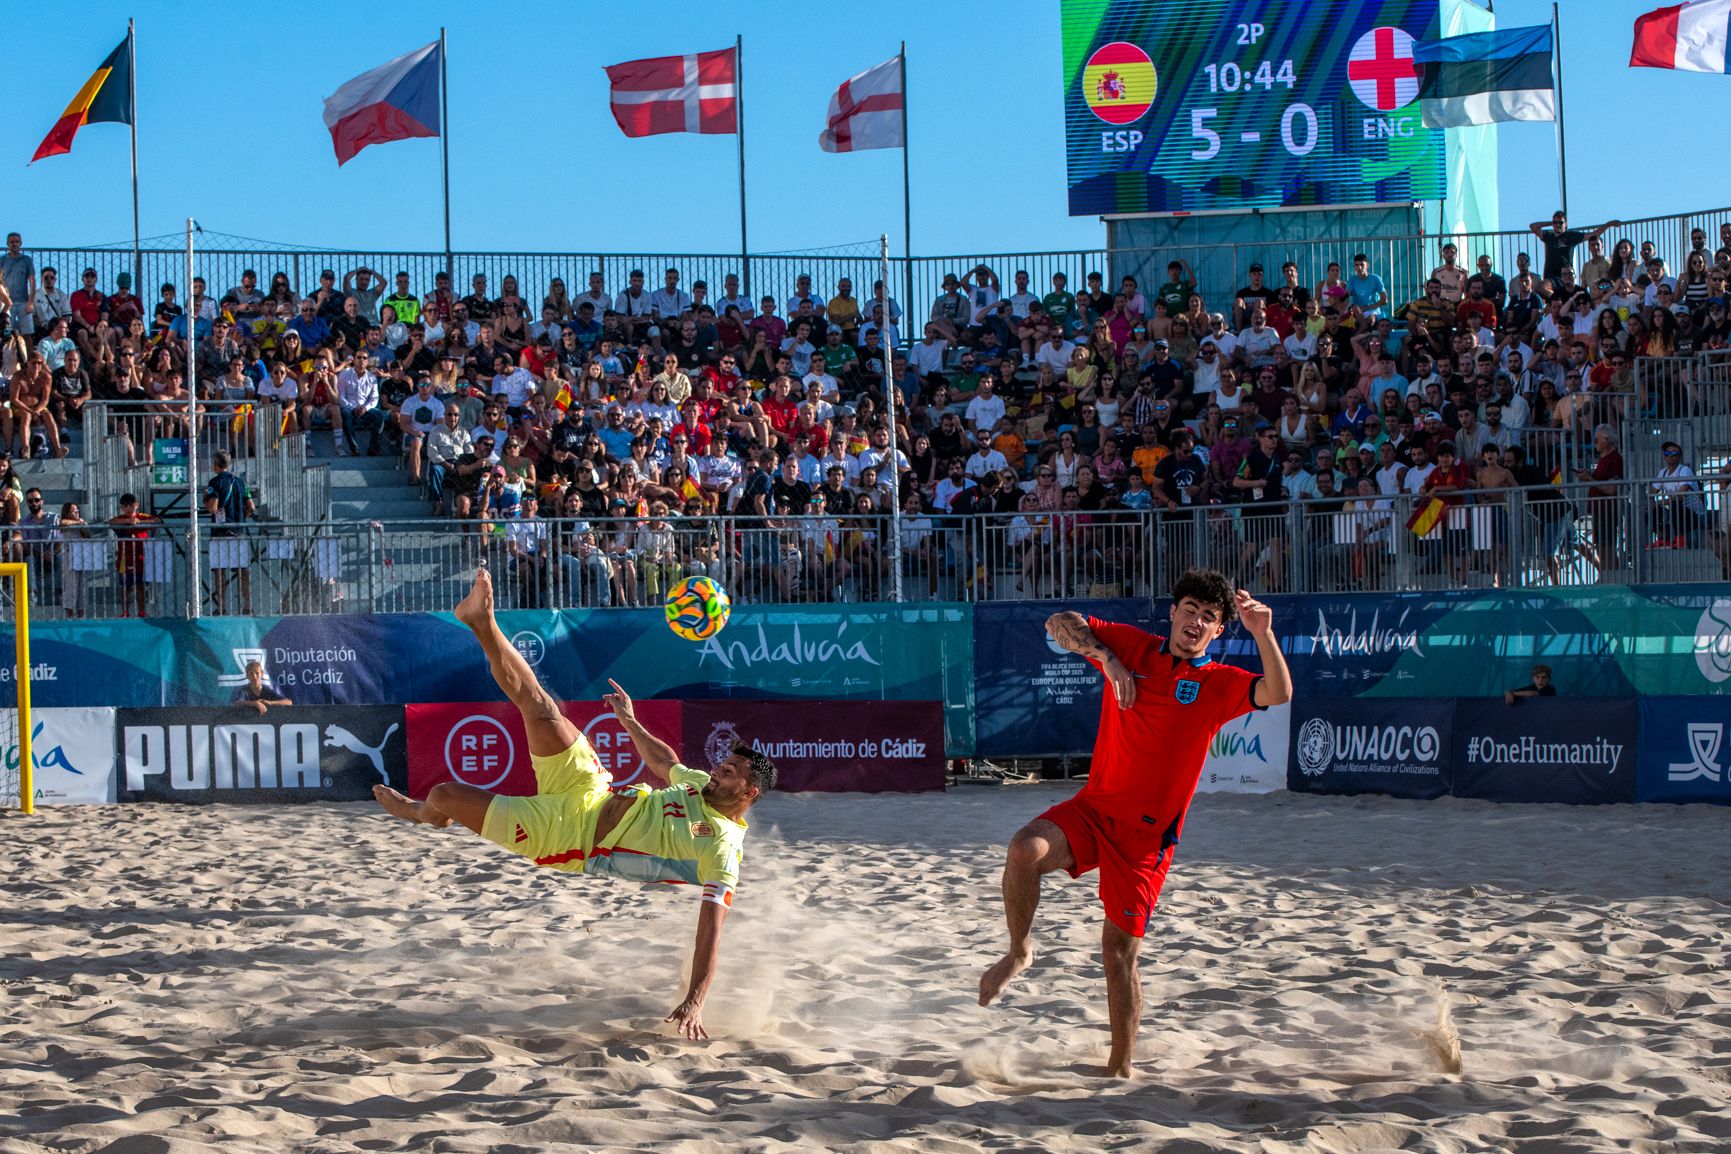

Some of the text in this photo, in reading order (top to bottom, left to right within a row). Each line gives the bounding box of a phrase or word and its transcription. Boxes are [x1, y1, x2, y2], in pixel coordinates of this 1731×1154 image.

[1237, 23, 1265, 45] 2P
[1204, 60, 1297, 93] 10:44
[1191, 108, 1221, 160] 5
[1281, 103, 1318, 156] 0
[1363, 116, 1414, 140] ENG
[1102, 130, 1144, 153] ESP
[1310, 606, 1425, 659] Andalucía
[275, 646, 357, 665] Diputación
[695, 620, 881, 670] Andalucía
[0, 665, 10, 681] e
[277, 668, 344, 686] de Cádiz
[1065, 676, 1096, 685] QUALIFIER
[462, 734, 498, 750] RF
[751, 738, 926, 758] Ayuntamiento de Cádiz
[1336, 726, 1413, 760] UNAOC
[124, 723, 321, 791] PUMA
[462, 755, 498, 772] EF
[1467, 736, 1623, 774] #OneHumanity
[1333, 763, 1439, 775] United Nations Alliance of Civilizations
